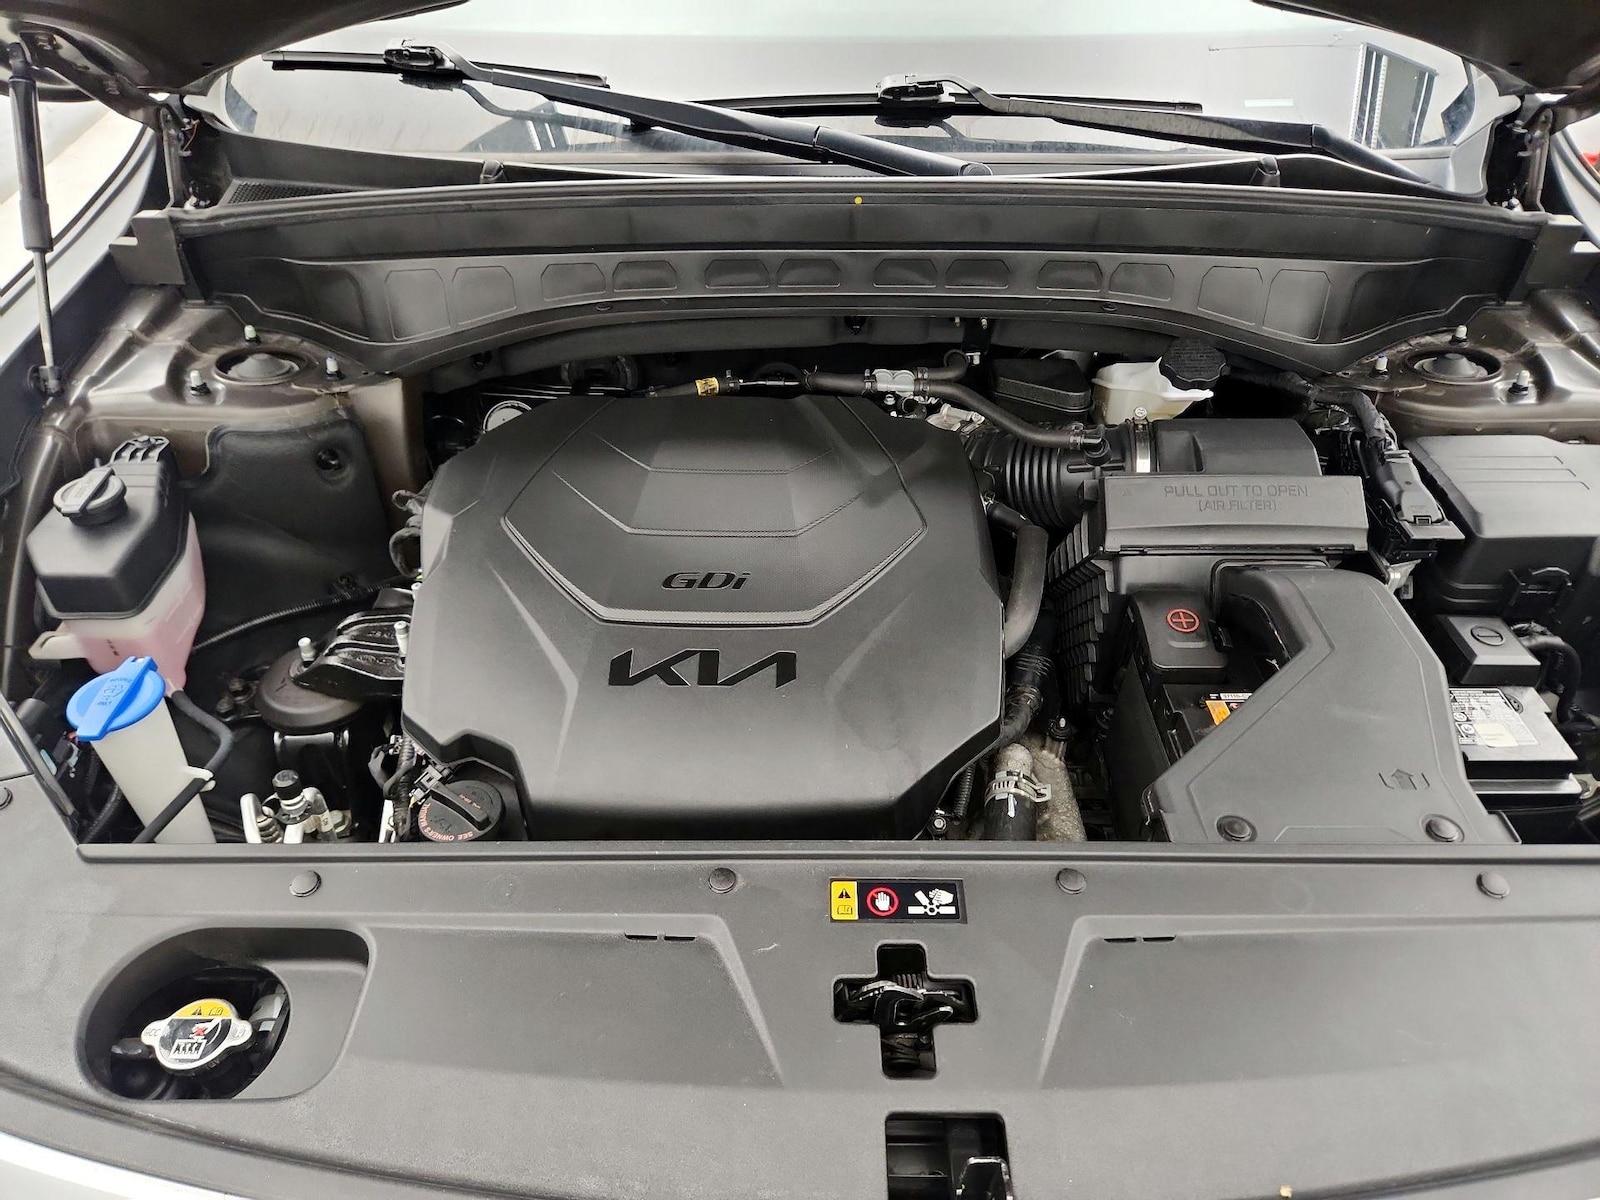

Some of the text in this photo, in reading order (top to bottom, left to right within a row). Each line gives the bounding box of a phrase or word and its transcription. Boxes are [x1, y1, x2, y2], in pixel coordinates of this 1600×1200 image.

[1164, 485, 1308, 497] PULL OUT TO OPEN
[662, 571, 751, 590] GDi
[608, 648, 797, 689] KIA
[424, 826, 455, 841] OWNERS
[457, 831, 474, 841] SEE
